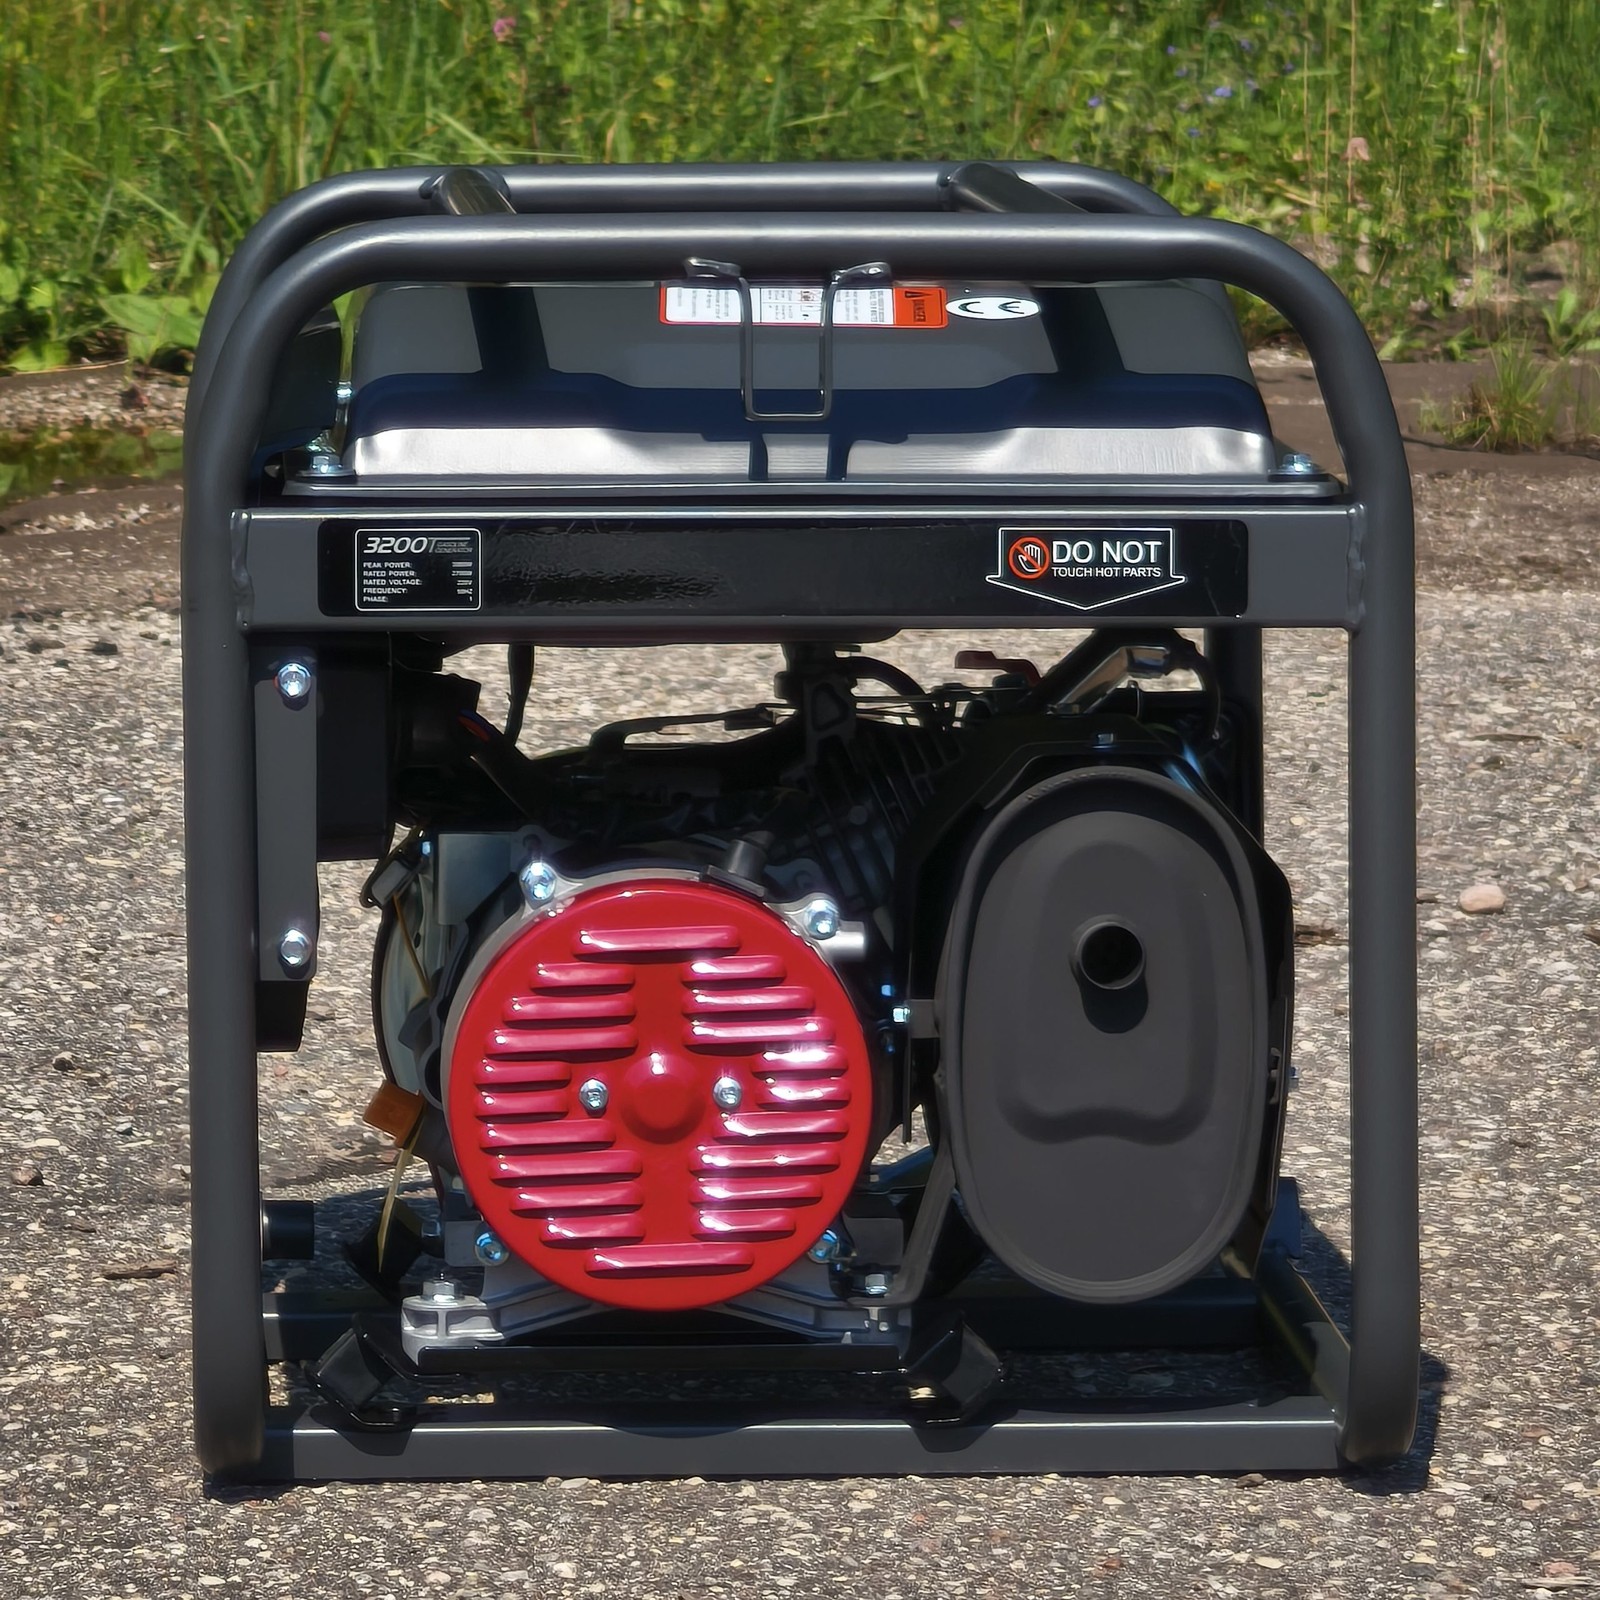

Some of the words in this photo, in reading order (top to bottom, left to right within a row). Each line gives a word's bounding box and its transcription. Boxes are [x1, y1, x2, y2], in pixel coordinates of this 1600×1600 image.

[958, 301, 1025, 315] CE
[1052, 540, 1094, 563] DO
[1102, 540, 1163, 563] NOT
[1051, 567, 1093, 577] TOUCH
[1095, 567, 1120, 577] HOT
[1122, 567, 1162, 577] PARTS
